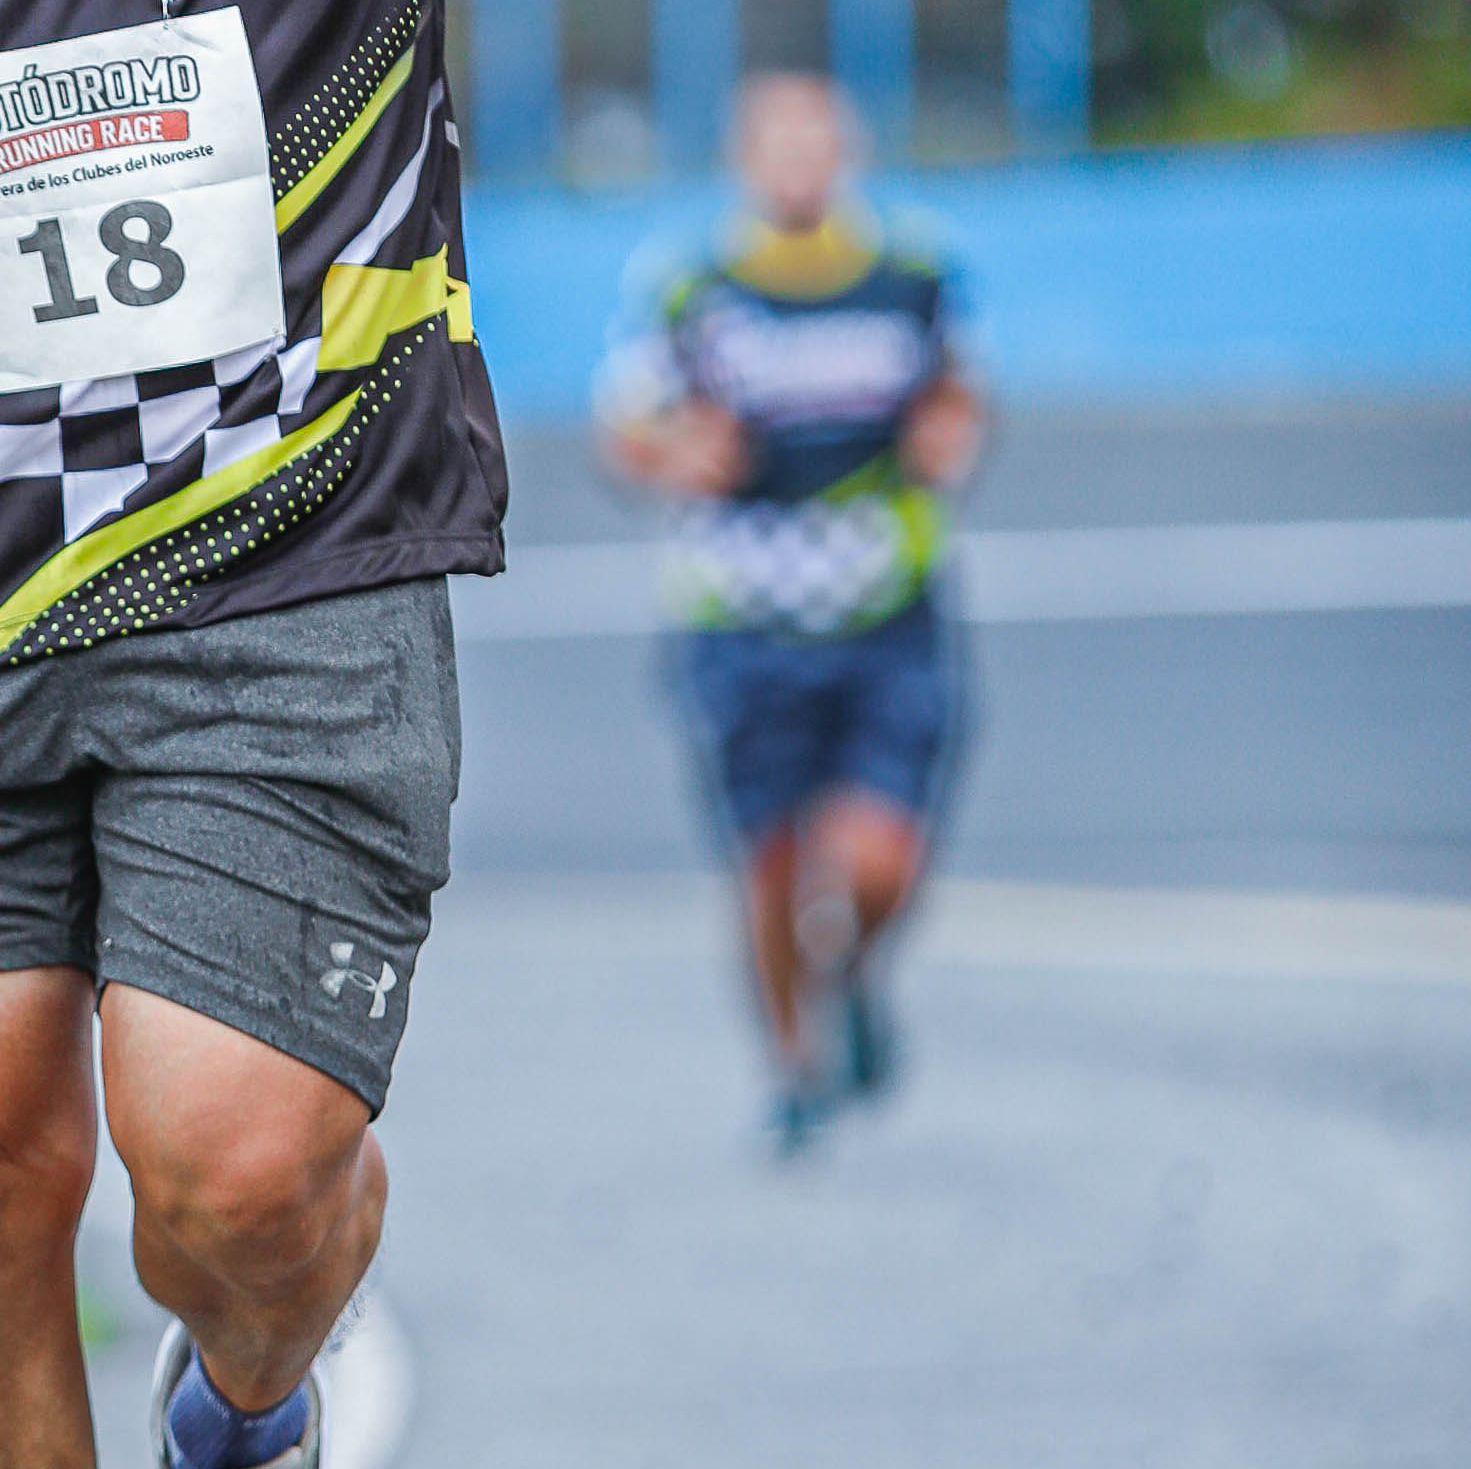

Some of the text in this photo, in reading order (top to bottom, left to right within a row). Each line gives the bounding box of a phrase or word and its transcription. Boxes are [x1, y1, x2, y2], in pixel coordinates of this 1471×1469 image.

[100, 114, 164, 146] RACE
[26, 176, 46, 191] de
[48, 173, 70, 188] los
[72, 164, 122, 182] Clubes
[124, 154, 148, 171] del
[150, 144, 216, 167] Noroeste
[16, 199, 186, 323] 18
